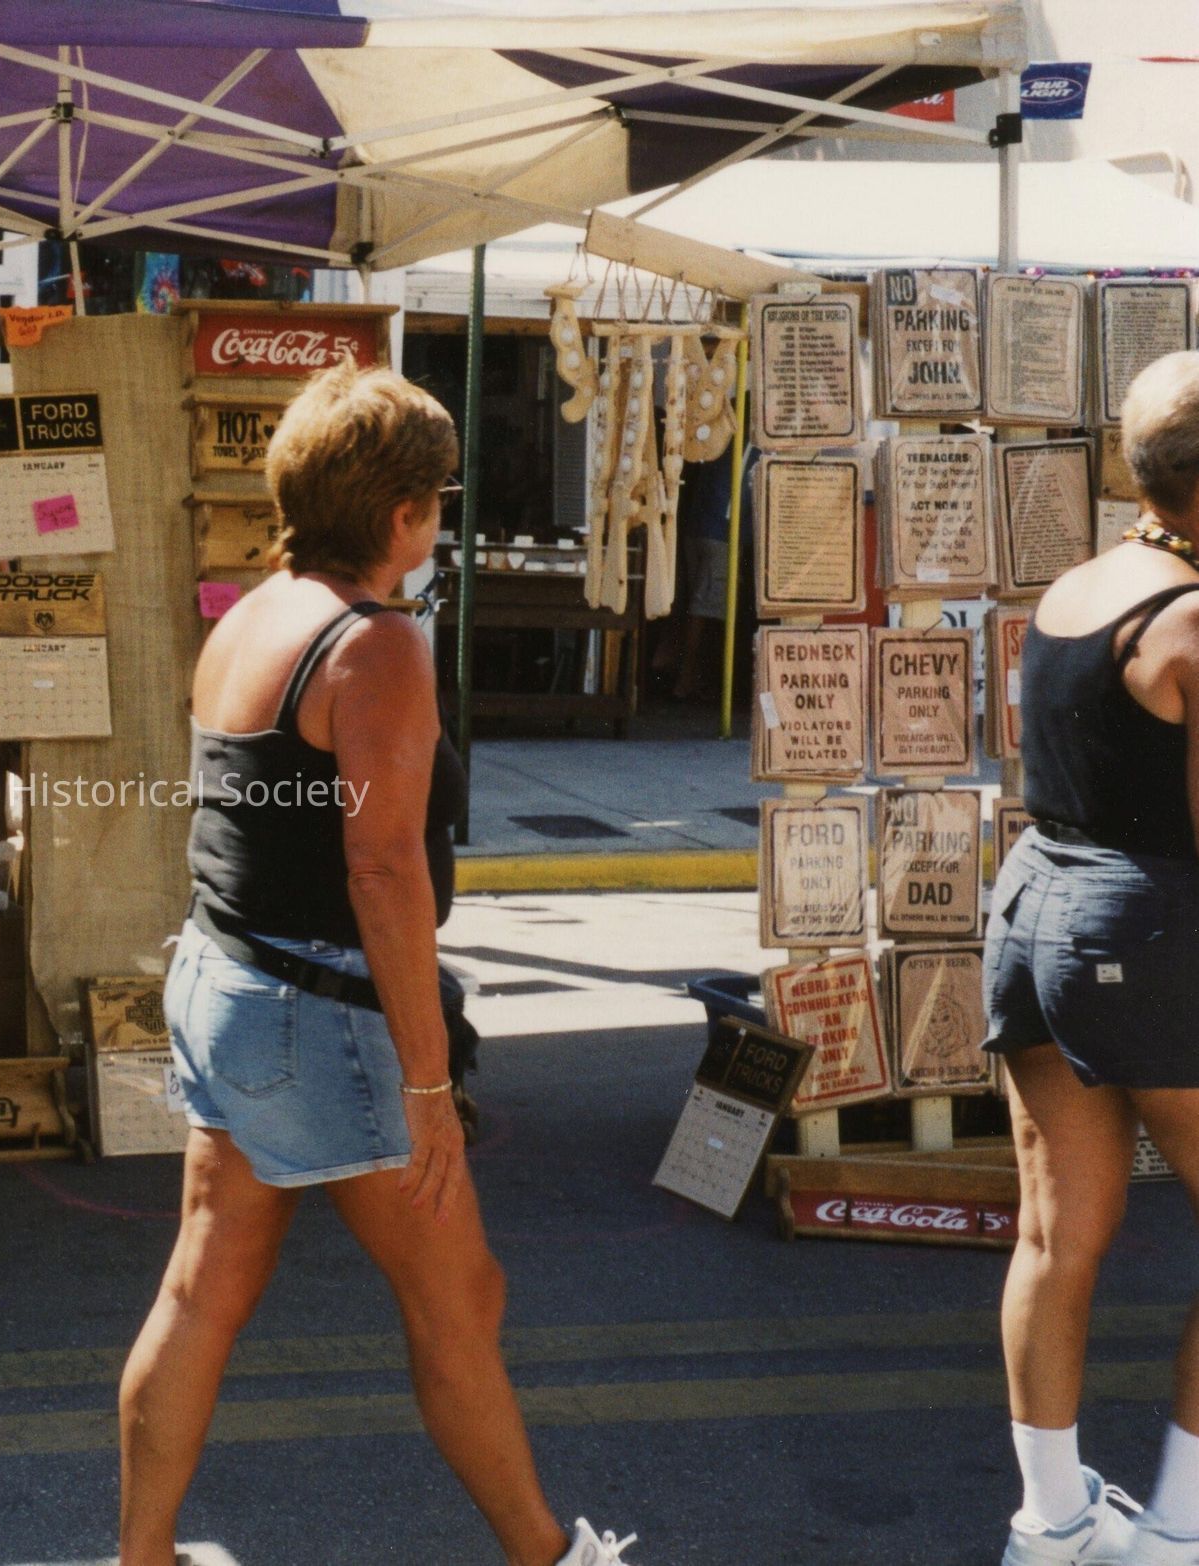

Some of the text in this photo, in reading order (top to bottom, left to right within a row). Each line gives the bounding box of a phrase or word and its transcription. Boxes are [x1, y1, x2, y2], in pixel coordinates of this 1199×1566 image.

[1021, 88, 1074, 98] LIGHT
[1031, 80, 1070, 89] BUD
[888, 275, 913, 301] NO
[894, 309, 970, 331] PARKING
[908, 361, 962, 385] JOHN
[31, 402, 88, 421] FORD
[26, 422, 96, 440] TRUCKS
[217, 411, 261, 444] HOT
[774, 644, 856, 662] REDNECK
[889, 653, 960, 676] CHEVY
[780, 673, 849, 689] PARKING
[897, 686, 950, 699] PARKING
[794, 694, 835, 710] ONLY
[909, 705, 940, 718] ONLY
[780, 721, 851, 731] VIOLATORS
[790, 736, 842, 745] WILL BE
[785, 750, 848, 760] VIOLATED
[787, 823, 844, 847] FORD
[892, 831, 970, 853] PARKING
[790, 857, 843, 870] PARKING
[940, 860, 959, 873] FOR
[802, 877, 832, 890] ONLY
[908, 881, 953, 905] DAD
[745, 1043, 788, 1071] FORD
[734, 1061, 783, 1095] TRUCKS
